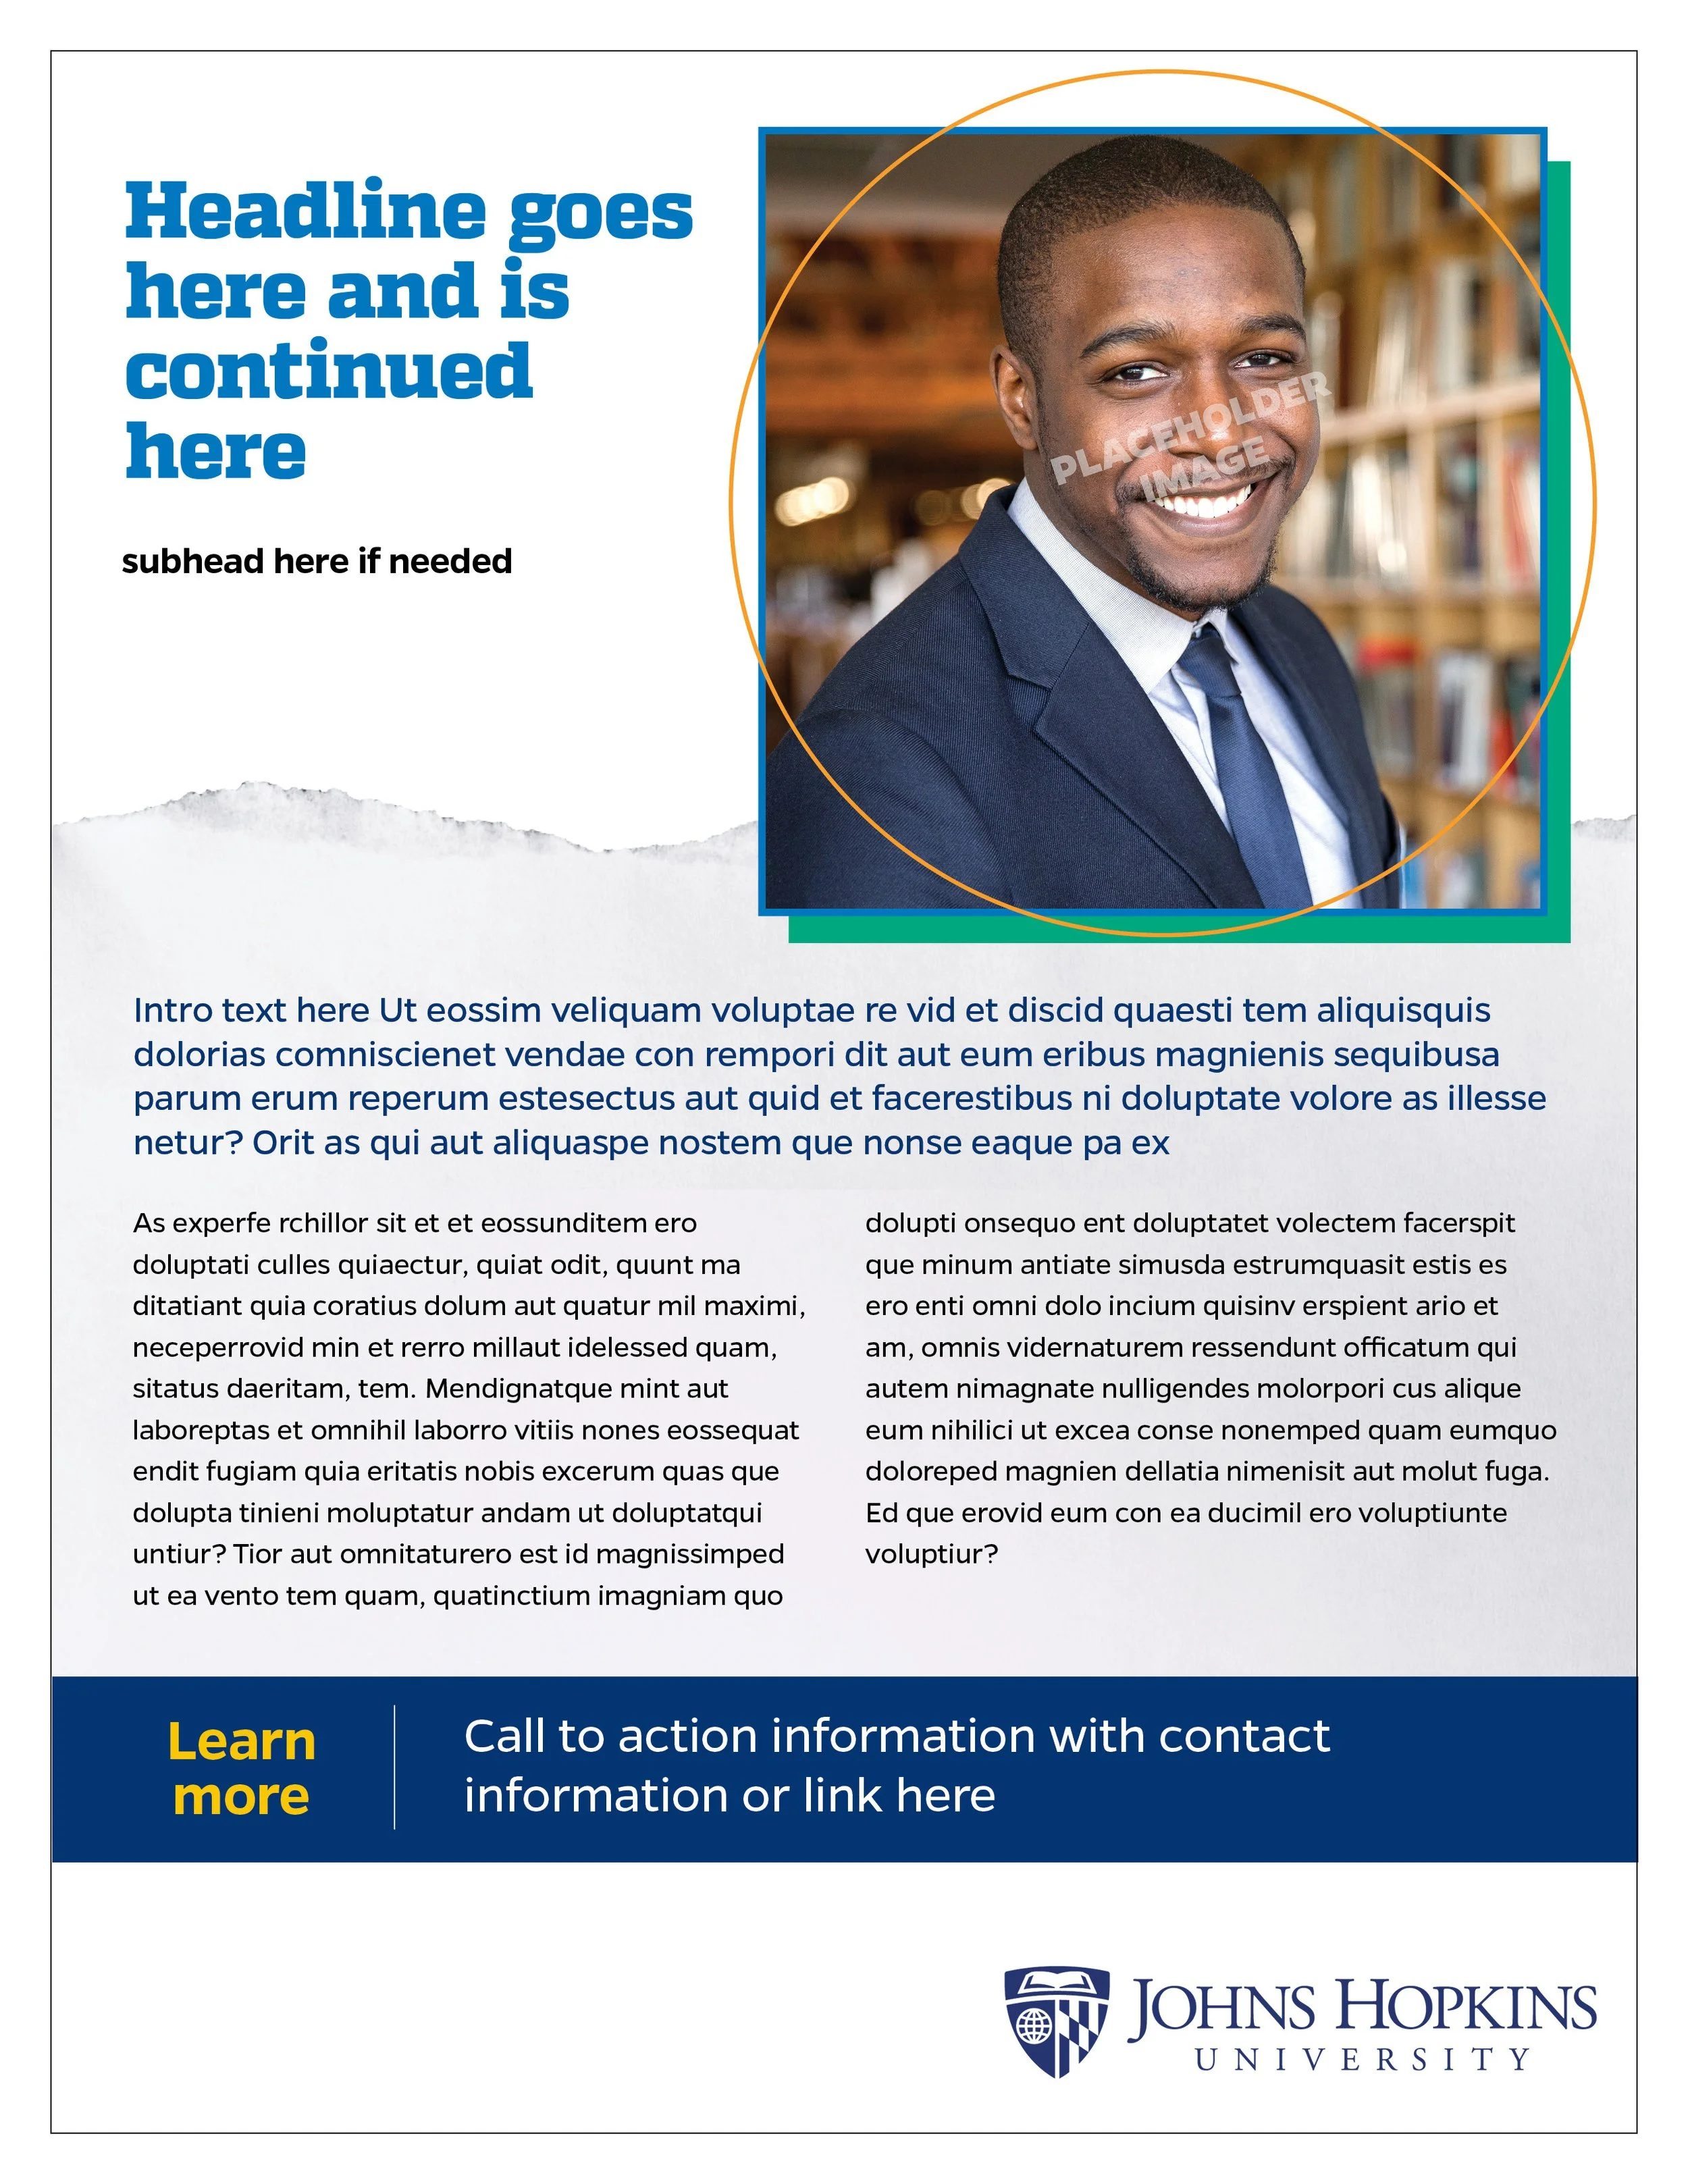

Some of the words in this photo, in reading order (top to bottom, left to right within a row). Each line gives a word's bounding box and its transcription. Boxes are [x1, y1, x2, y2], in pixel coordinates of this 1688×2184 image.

[126, 176, 486, 240] Headline
[508, 192, 693, 254] goes
[126, 261, 306, 319] here
[328, 261, 479, 319] and
[500, 255, 569, 319] is
[126, 336, 533, 400] continued
[126, 421, 306, 480] here
[122, 548, 263, 574] subhead
[275, 548, 349, 574] here
[359, 545, 381, 574] if
[390, 548, 512, 574] needed
[136, 997, 213, 1023] Intro
[221, 998, 287, 1023] text
[298, 996, 369, 1023] here
[381, 997, 417, 1023] Ut
[427, 996, 540, 1023] eossim
[551, 996, 701, 1028] veliquam
[711, 996, 855, 1028] voluptae
[866, 1003, 897, 1023] re
[906, 996, 955, 1023] vid
[966, 998, 999, 1023] et
[1009, 996, 1103, 1023] discid
[1113, 996, 1232, 1028] quaesti
[1242, 998, 1307, 1023] tem
[1317, 996, 1491, 1028] aliquisquis
[134, 1040, 265, 1067] dolorias
[275, 1040, 496, 1067] comniscienet
[504, 1040, 625, 1067] vendae
[635, 1047, 693, 1067] con
[706, 1040, 834, 1073] rempori
[845, 1040, 888, 1067] dit
[897, 1042, 951, 1067] aut
[961, 1047, 1032, 1067] eum
[1043, 1040, 1145, 1067] eribus
[1157, 1040, 1324, 1073] magnienis
[1334, 1040, 1499, 1073] sequibusa
[135, 1090, 240, 1117] parum
[251, 1090, 338, 1111] erum
[350, 1090, 488, 1117] reperum
[499, 1086, 675, 1111] estesectus
[685, 1086, 739, 1111] aut
[748, 1084, 819, 1117] quid
[830, 1086, 863, 1111] et
[872, 1084, 1072, 1111] facerestibus
[1084, 1084, 1110, 1111] ni
[1122, 1084, 1280, 1117] doluptate
[1290, 1084, 1392, 1111] volore
[1403, 1090, 1438, 1111] as
[1449, 1084, 1546, 1111] illesse
[135, 1129, 244, 1155] netur?
[253, 1128, 315, 1155] Orit
[324, 1135, 360, 1155] as
[371, 1128, 419, 1161] qui
[430, 1131, 483, 1155] aut
[493, 1128, 649, 1161] aliquaspe
[660, 1131, 781, 1155] nostem
[792, 1135, 853, 1161] que
[864, 1135, 962, 1155] nonse
[972, 1135, 1072, 1161] eaque
[1084, 1135, 1121, 1161] pa
[1132, 1135, 1170, 1155] ex
[132, 1213, 165, 1233] As
[173, 1211, 271, 1237] experfe
[280, 1212, 369, 1233] rchillor
[377, 1212, 406, 1233] sit
[415, 1214, 440, 1233] et
[448, 1214, 473, 1233] et
[481, 1212, 647, 1233] eossunditem
[655, 1217, 697, 1233] ero
[866, 1212, 956, 1237] dolupti
[964, 1217, 1076, 1237] onsequo
[1084, 1214, 1126, 1233] ent
[1133, 1212, 1269, 1237] doluptatet
[1275, 1212, 1396, 1233] volectem
[1403, 1211, 1516, 1237] facerspit
[133, 1294, 242, 1316] ditatiant
[250, 1295, 305, 1321] quia
[313, 1295, 417, 1316] coratius
[424, 1294, 506, 1316] dolum
[515, 1296, 556, 1316] aut
[563, 1296, 651, 1321] quatur
[658, 1294, 695, 1316] mil
[705, 1295, 805, 1319] maximi,
[866, 1300, 908, 1316] ero
[916, 1295, 964, 1316] enti
[972, 1295, 1036, 1316] omni
[1045, 1294, 1101, 1316] dolo
[1109, 1294, 1195, 1316] incium
[1203, 1295, 1296, 1321] quisinv
[1302, 1295, 1408, 1321] erspient
[1416, 1294, 1466, 1316] ario
[1473, 1296, 1499, 1316] et
[133, 1377, 219, 1399] sitatus
[227, 1377, 350, 1402] daeritam,
[358, 1379, 416, 1399] tem.
[426, 1377, 612, 1404] Mendignatque
[621, 1377, 680, 1399] mint
[687, 1379, 729, 1399] aut
[866, 1379, 948, 1399] autem
[957, 1377, 1094, 1404] nimagnate
[1103, 1377, 1250, 1404] nulligendes
[1258, 1377, 1384, 1403] molorpori
[1393, 1383, 1436, 1399] cus
[1444, 1377, 1521, 1403] alique
[133, 1460, 199, 1481] endit
[206, 1460, 296, 1487] fugiam
[305, 1460, 359, 1486] quia
[367, 1460, 457, 1481] eritatis
[465, 1460, 535, 1481] nobis
[542, 1465, 654, 1481] excerum
[662, 1465, 724, 1486] quas
[731, 1465, 779, 1486] que
[866, 1460, 997, 1486] doloreped
[1006, 1460, 1116, 1487] magnien
[1126, 1460, 1219, 1481] dellatia
[1228, 1460, 1345, 1481] nimenisit
[1353, 1462, 1395, 1481] aut
[1402, 1460, 1478, 1481] molut
[1485, 1459, 1549, 1487] fuga.
[133, 1501, 232, 1528] dolupta
[239, 1501, 319, 1523] tinieni
[327, 1501, 474, 1528] moluptatur
[481, 1501, 570, 1523] andam
[579, 1503, 604, 1523] ut
[612, 1501, 762, 1528] doluptatqui
[134, 1543, 227, 1564] untiur?
[232, 1543, 283, 1564] Tior
[290, 1545, 332, 1564] aut
[340, 1543, 512, 1564] omnitaturero
[520, 1545, 558, 1564] est
[566, 1543, 588, 1564] id
[597, 1543, 784, 1569] magnissimped
[865, 1543, 999, 1568] voluptiur?
[169, 1722, 315, 1761] Learn
[465, 1717, 544, 1753] Call
[558, 1720, 604, 1753] to
[619, 1717, 756, 1753] action
[773, 1716, 1034, 1753] information
[1049, 1717, 1144, 1753] with
[1160, 1720, 1331, 1753] contact
[175, 1784, 309, 1815] more
[466, 1776, 727, 1812] information
[743, 1786, 791, 1812] or
[806, 1776, 883, 1812] link
[898, 1776, 995, 1812] here
[1127, 1978, 1315, 2044] JOHNS
[1335, 1978, 1598, 2030] HOPKINS
[1194, 2047, 1529, 2071] UNIVERSITY
